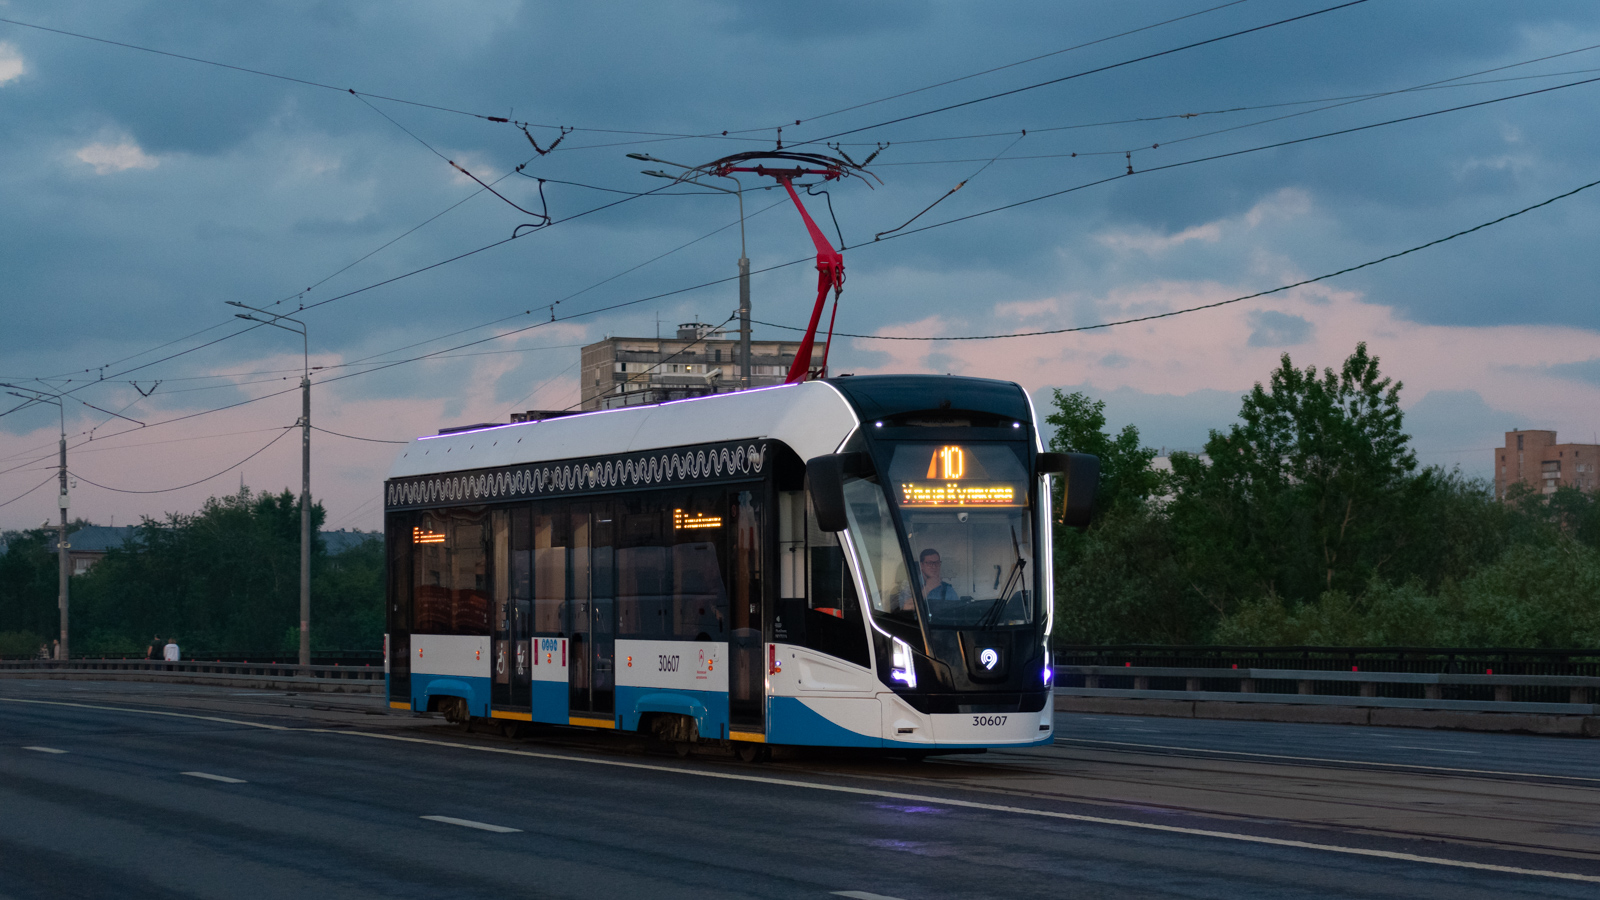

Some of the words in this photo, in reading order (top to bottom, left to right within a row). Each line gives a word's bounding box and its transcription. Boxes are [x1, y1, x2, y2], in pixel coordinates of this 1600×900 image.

[941, 446, 963, 479] 10
[658, 654, 680, 672] 30607
[972, 715, 1008, 727] 30607
